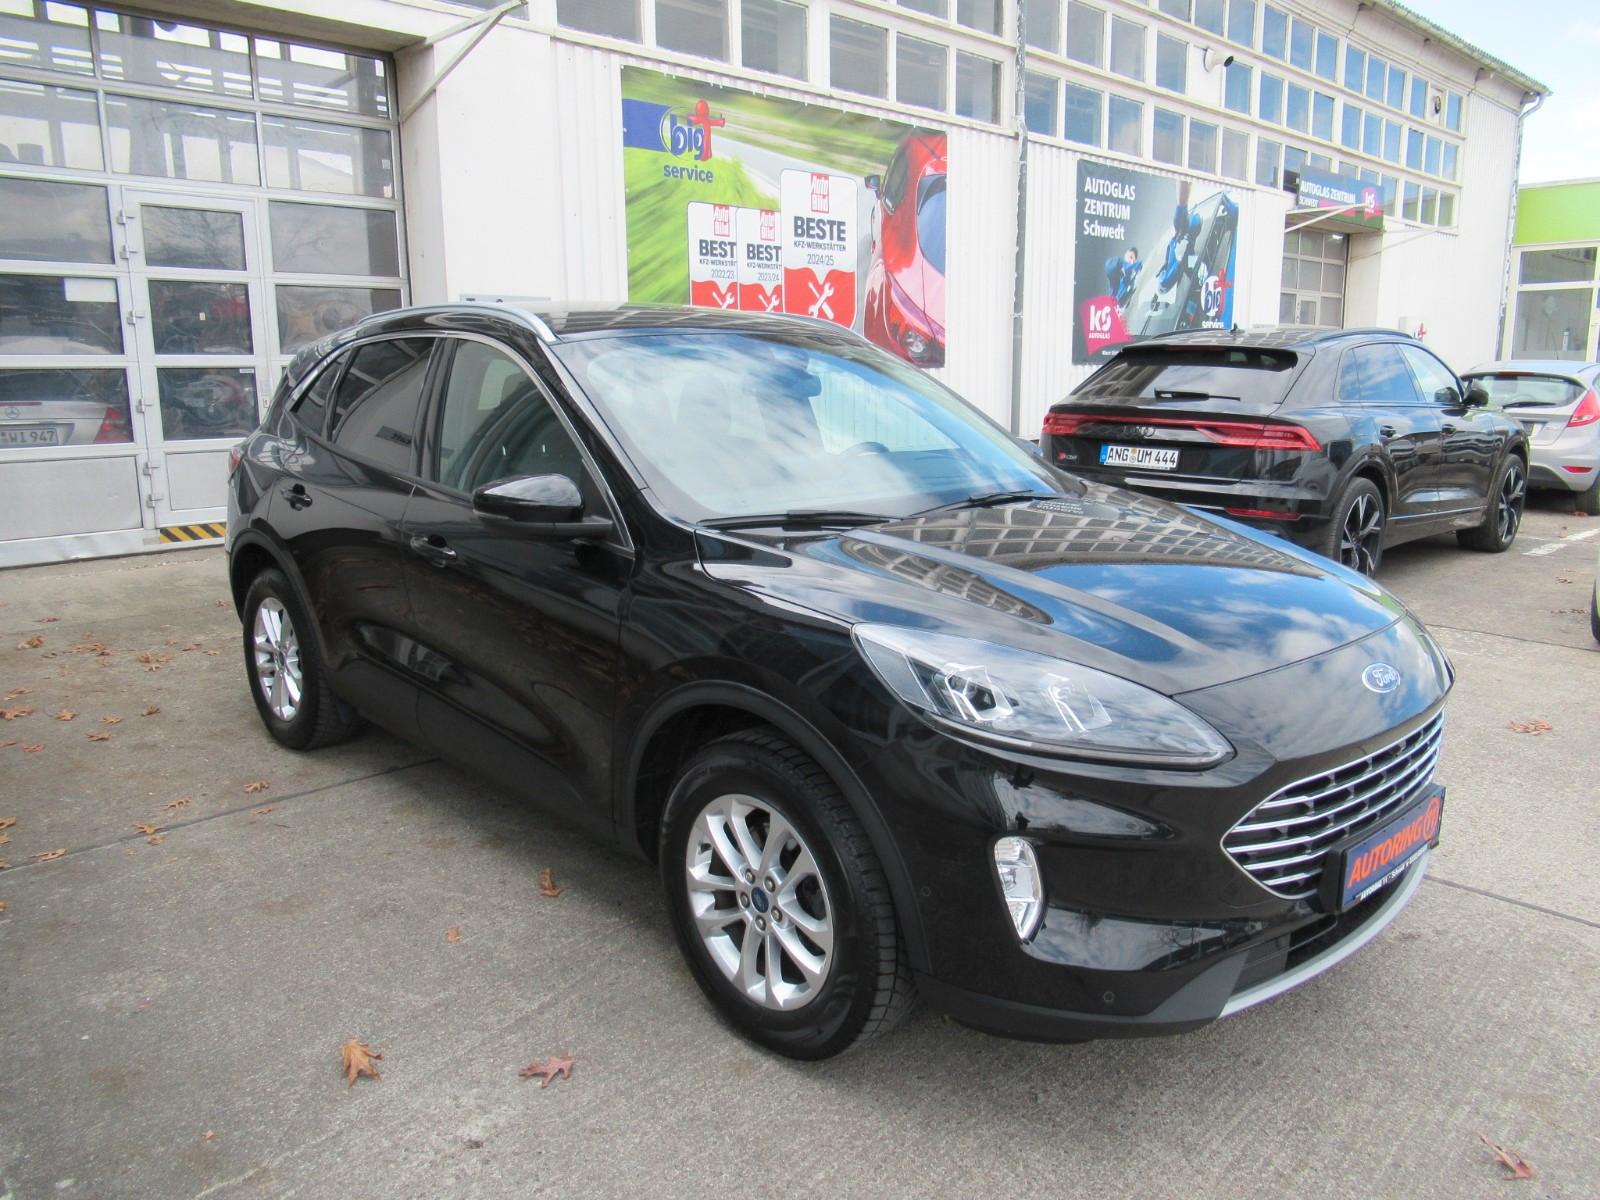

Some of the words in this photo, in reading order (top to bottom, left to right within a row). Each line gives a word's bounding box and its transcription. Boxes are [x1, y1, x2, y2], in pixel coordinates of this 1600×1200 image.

[663, 165, 714, 183] service
[1084, 177, 1136, 200] AUTOGLAS
[1300, 180, 1330, 198] AUTOGLAS
[1330, 187, 1356, 204] ZENTRUM
[1084, 198, 1131, 220] ZENTRUM
[793, 215, 847, 242] BESTE
[1083, 219, 1125, 240] Schwedt
[793, 240, 847, 252] KFZ-WERKSTÄTTEN
[807, 253, 835, 266] 2024/25
[30, 431, 55, 443] 947
[1107, 447, 1130, 461] ANG
[1137, 448, 1153, 463] UM
[1154, 450, 1176, 466] 444
